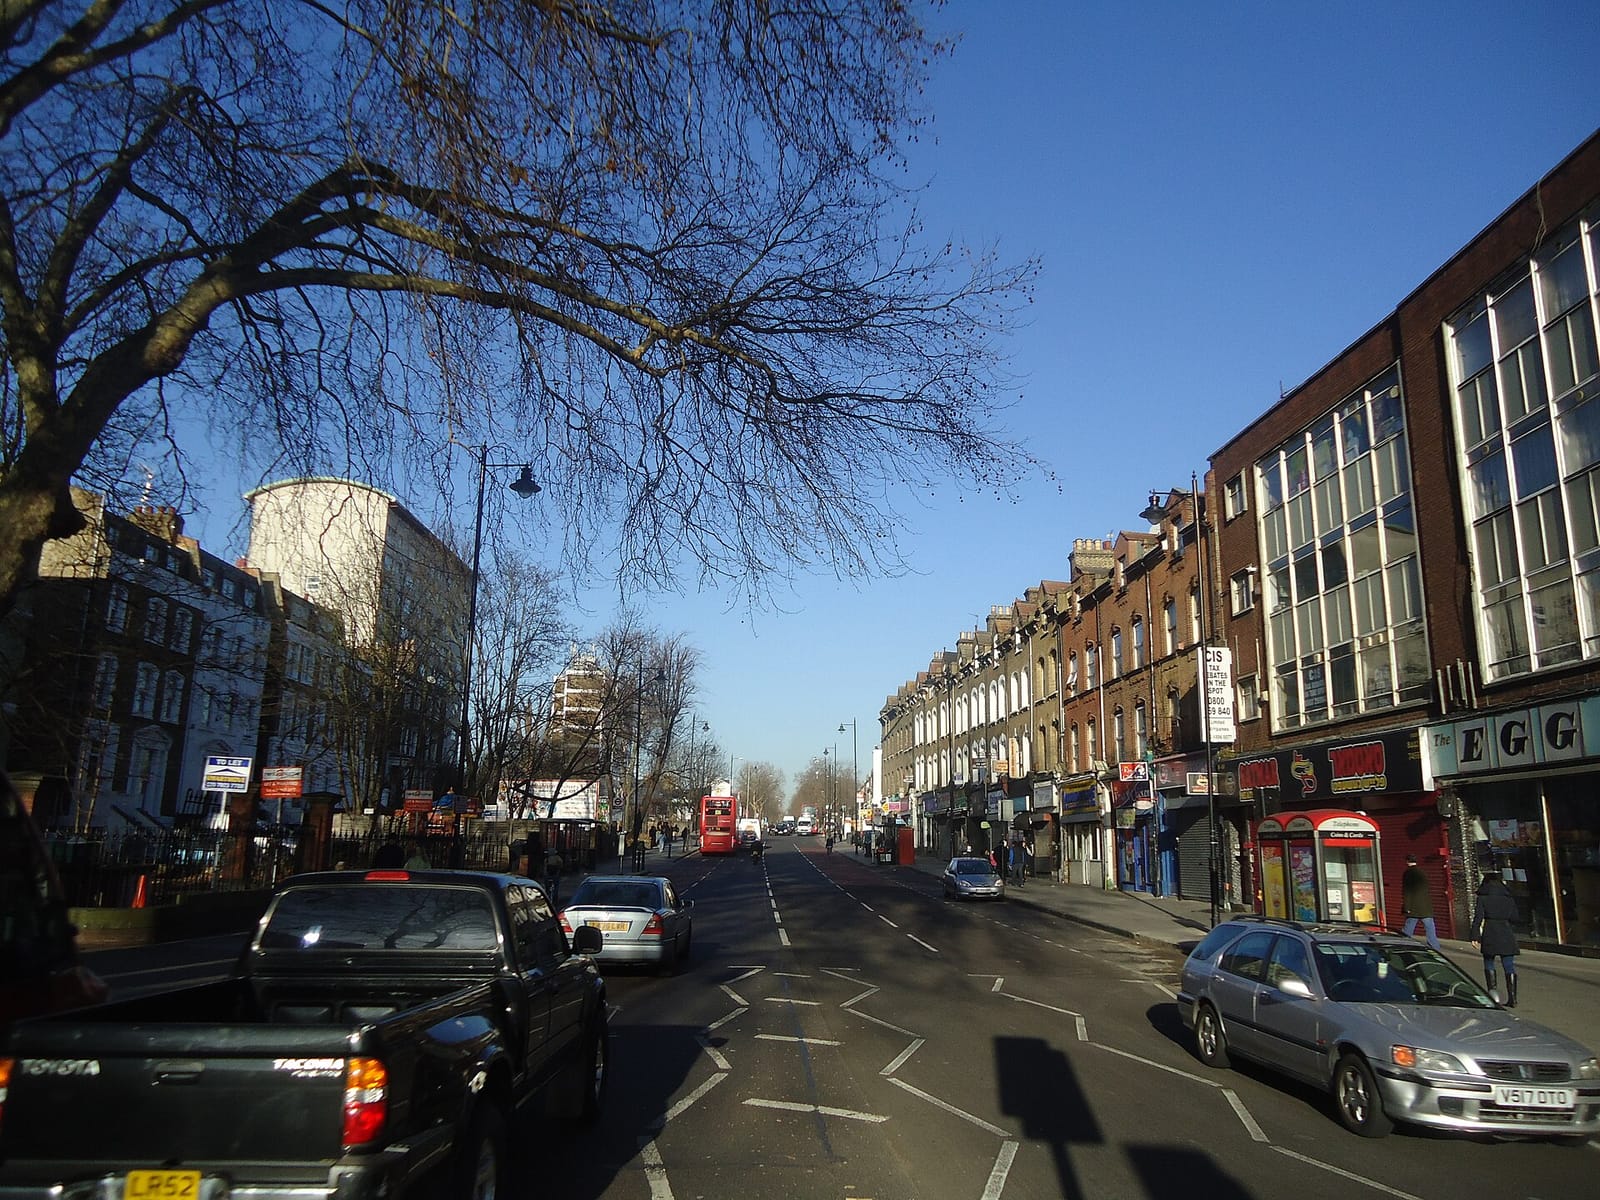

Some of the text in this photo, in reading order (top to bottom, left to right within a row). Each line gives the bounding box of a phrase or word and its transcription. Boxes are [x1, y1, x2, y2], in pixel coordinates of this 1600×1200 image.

[1205, 650, 1223, 662] CIS
[1433, 733, 1451, 747] The
[1460, 711, 1580, 762] EGG
[216, 758, 227, 766] TO
[20, 1058, 100, 1076] TOYOTA
[1500, 1088, 1534, 1104] V517
[129, 1175, 193, 1199] LR52
